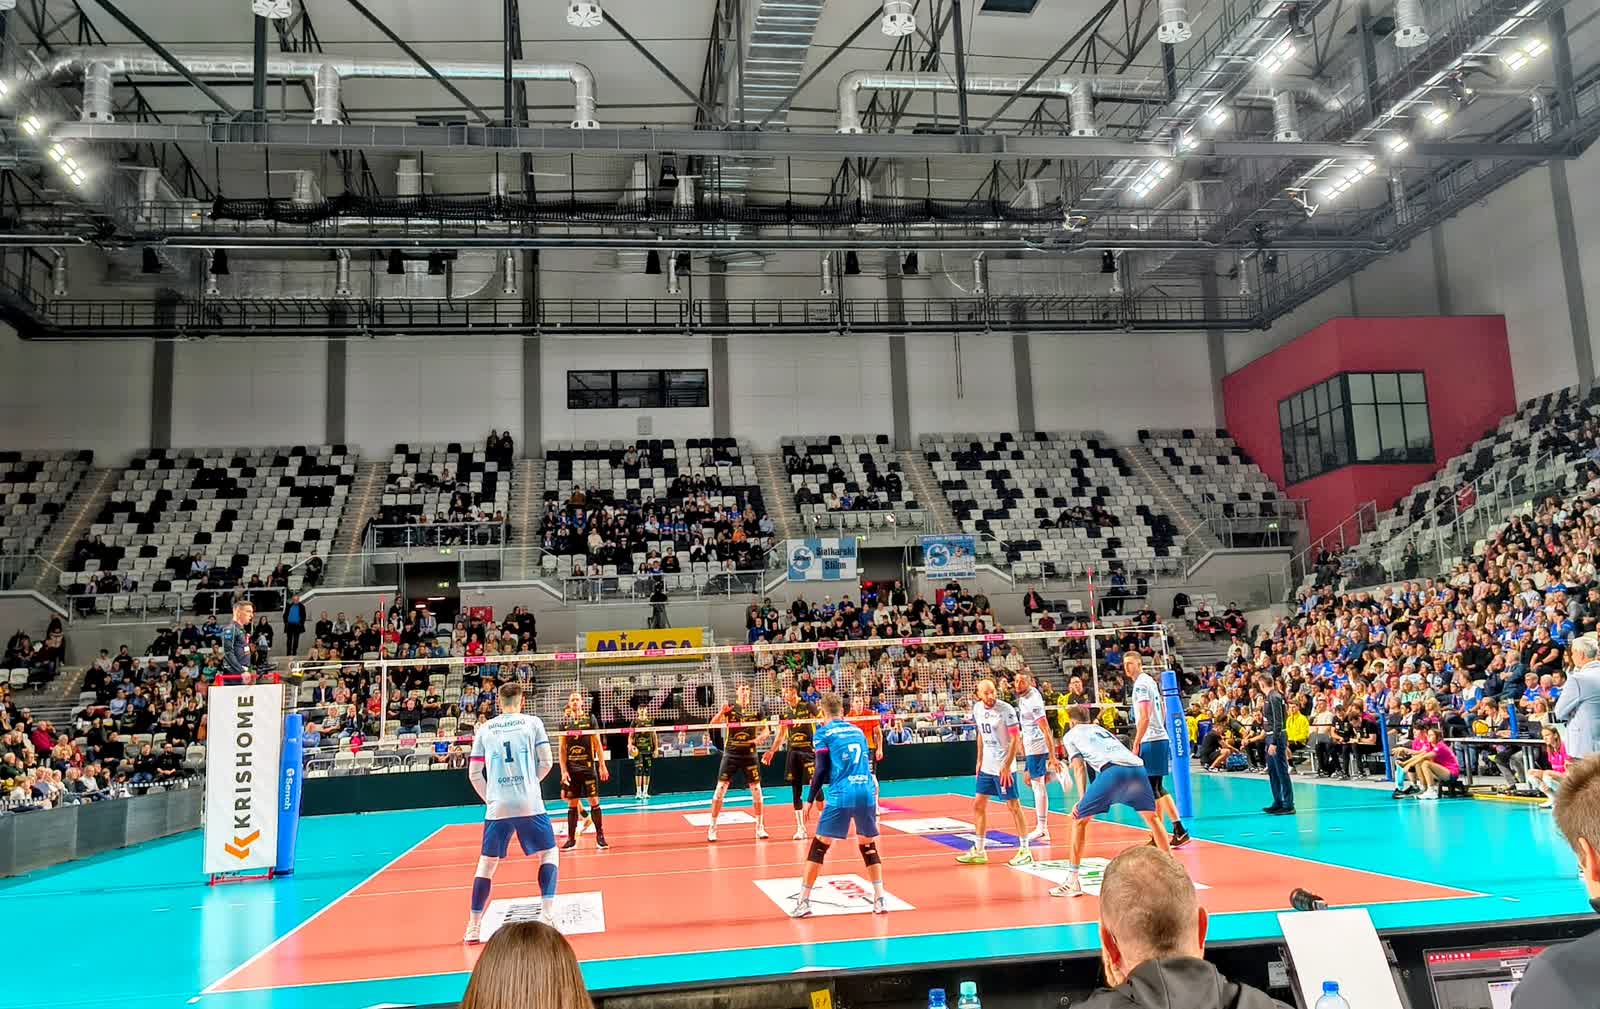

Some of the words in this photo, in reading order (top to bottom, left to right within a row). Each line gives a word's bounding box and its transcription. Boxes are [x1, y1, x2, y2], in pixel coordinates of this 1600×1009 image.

[981, 723, 992, 734] 10
[502, 741, 514, 762] 1
[847, 743, 862, 764] 7
[1175, 727, 1184, 756] Senoh
[234, 695, 254, 829] KRISHOME
[283, 777, 294, 810] Senoh
